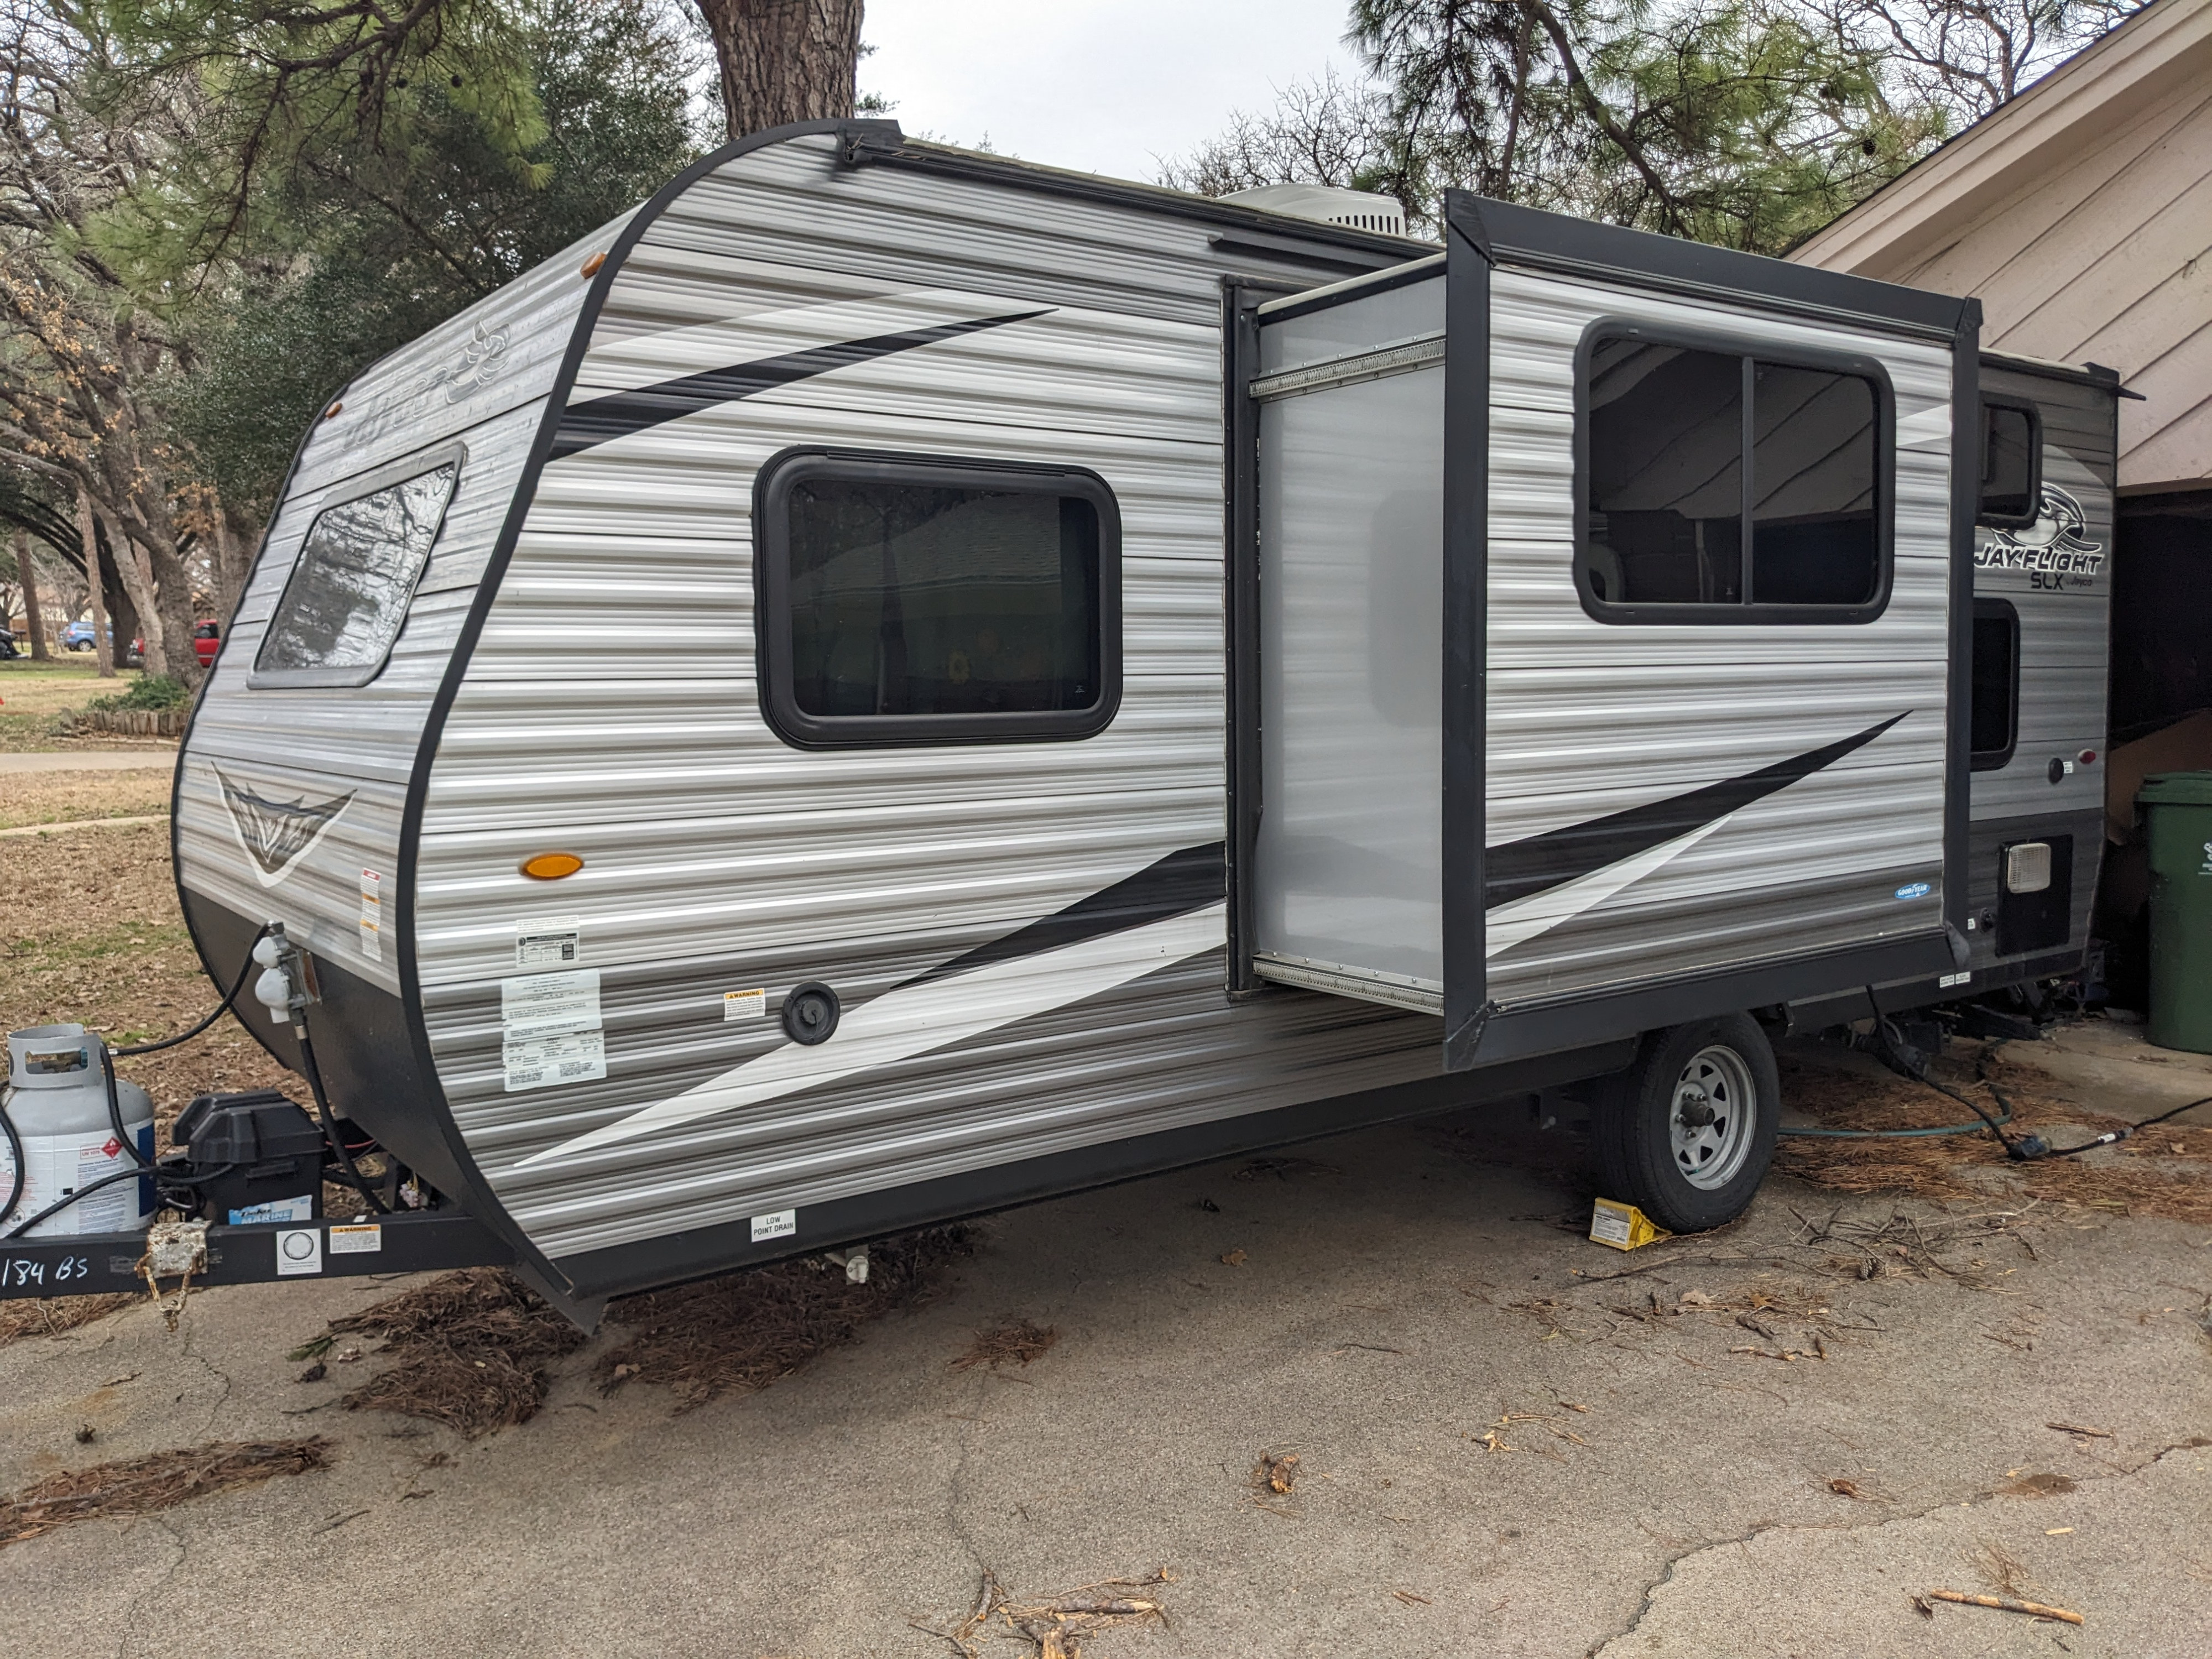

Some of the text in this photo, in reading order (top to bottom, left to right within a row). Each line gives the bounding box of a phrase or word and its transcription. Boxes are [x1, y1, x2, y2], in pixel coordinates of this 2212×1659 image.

[2031, 572, 2063, 590] SLX
[766, 1216, 781, 1224] LOW
[754, 1222, 794, 1235] POINT DRAIN
[2, 1255, 88, 1286] 184 BS
